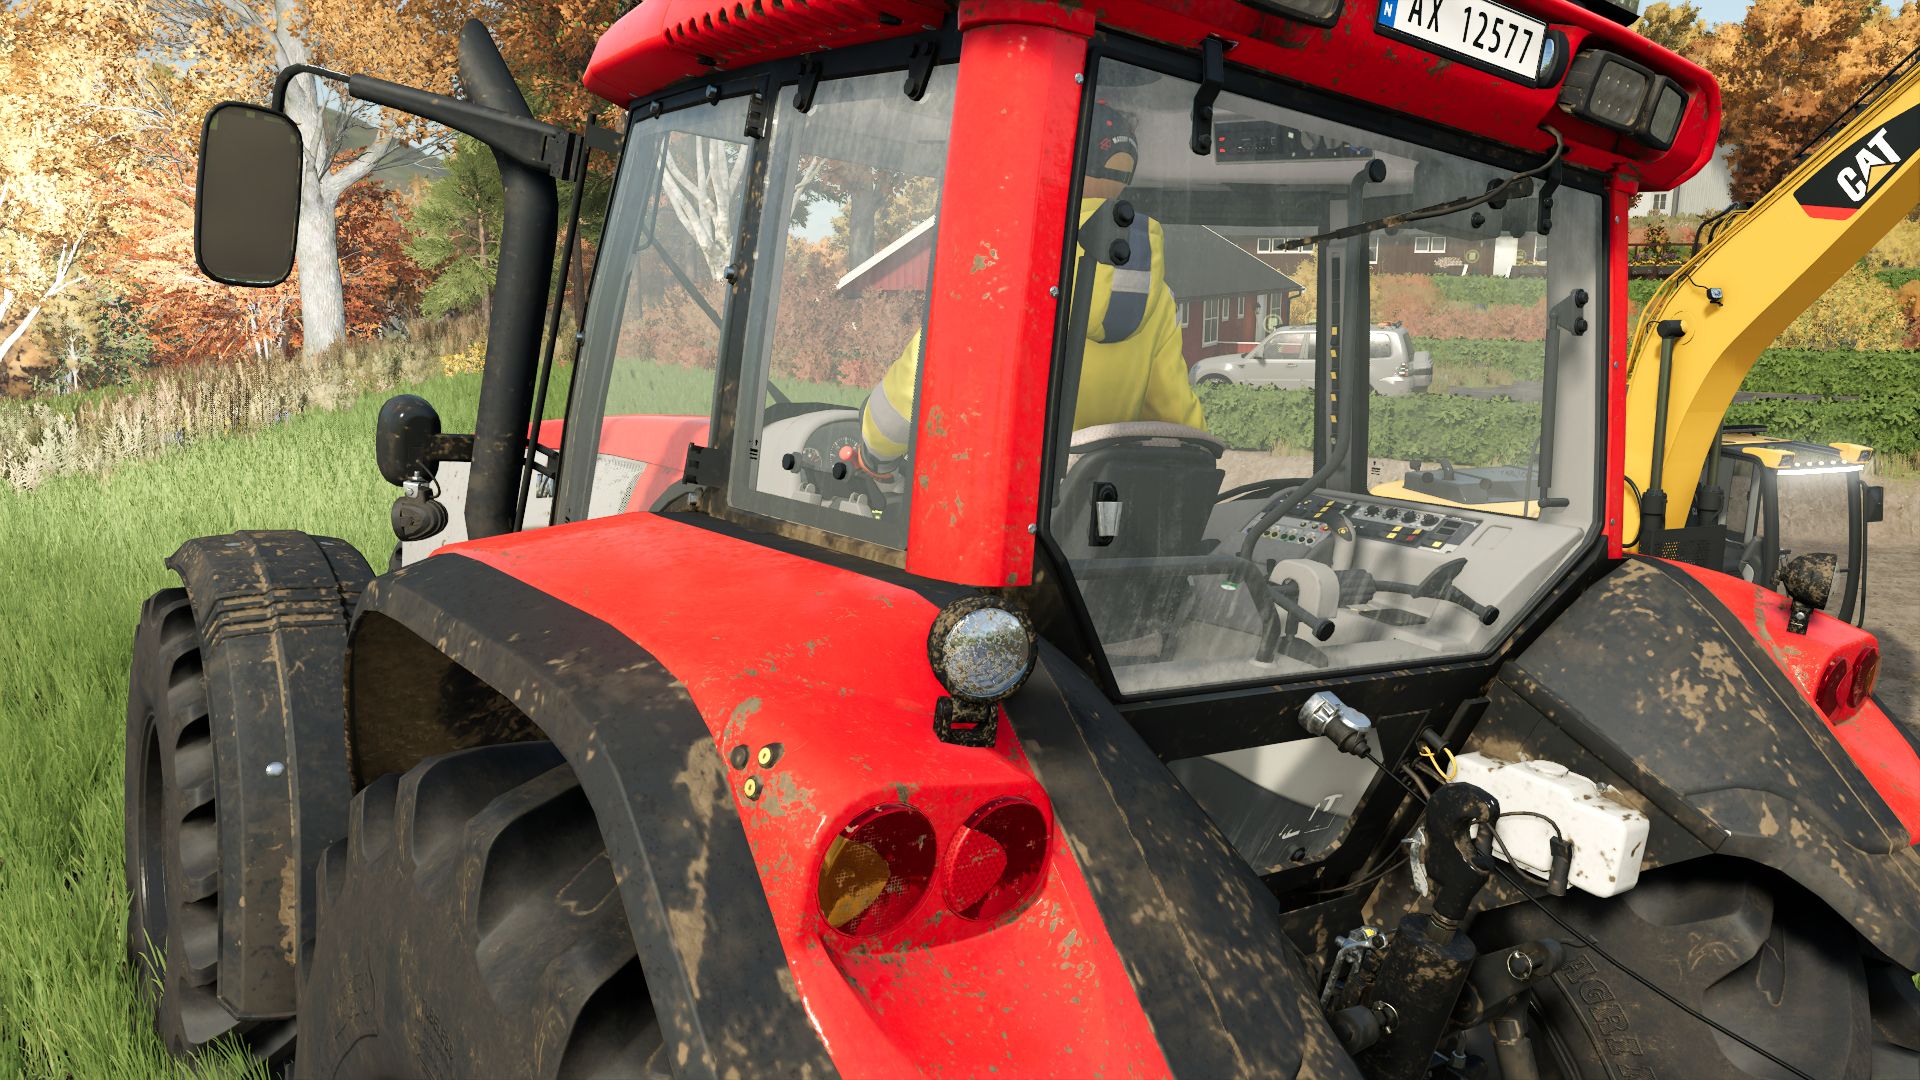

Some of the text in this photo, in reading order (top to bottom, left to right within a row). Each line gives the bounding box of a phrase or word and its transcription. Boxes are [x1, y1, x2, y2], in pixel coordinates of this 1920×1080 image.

[1383, 3, 1393, 18] N
[1407, 0, 1534, 64] AX 12577
[1836, 127, 1902, 202] CAT
